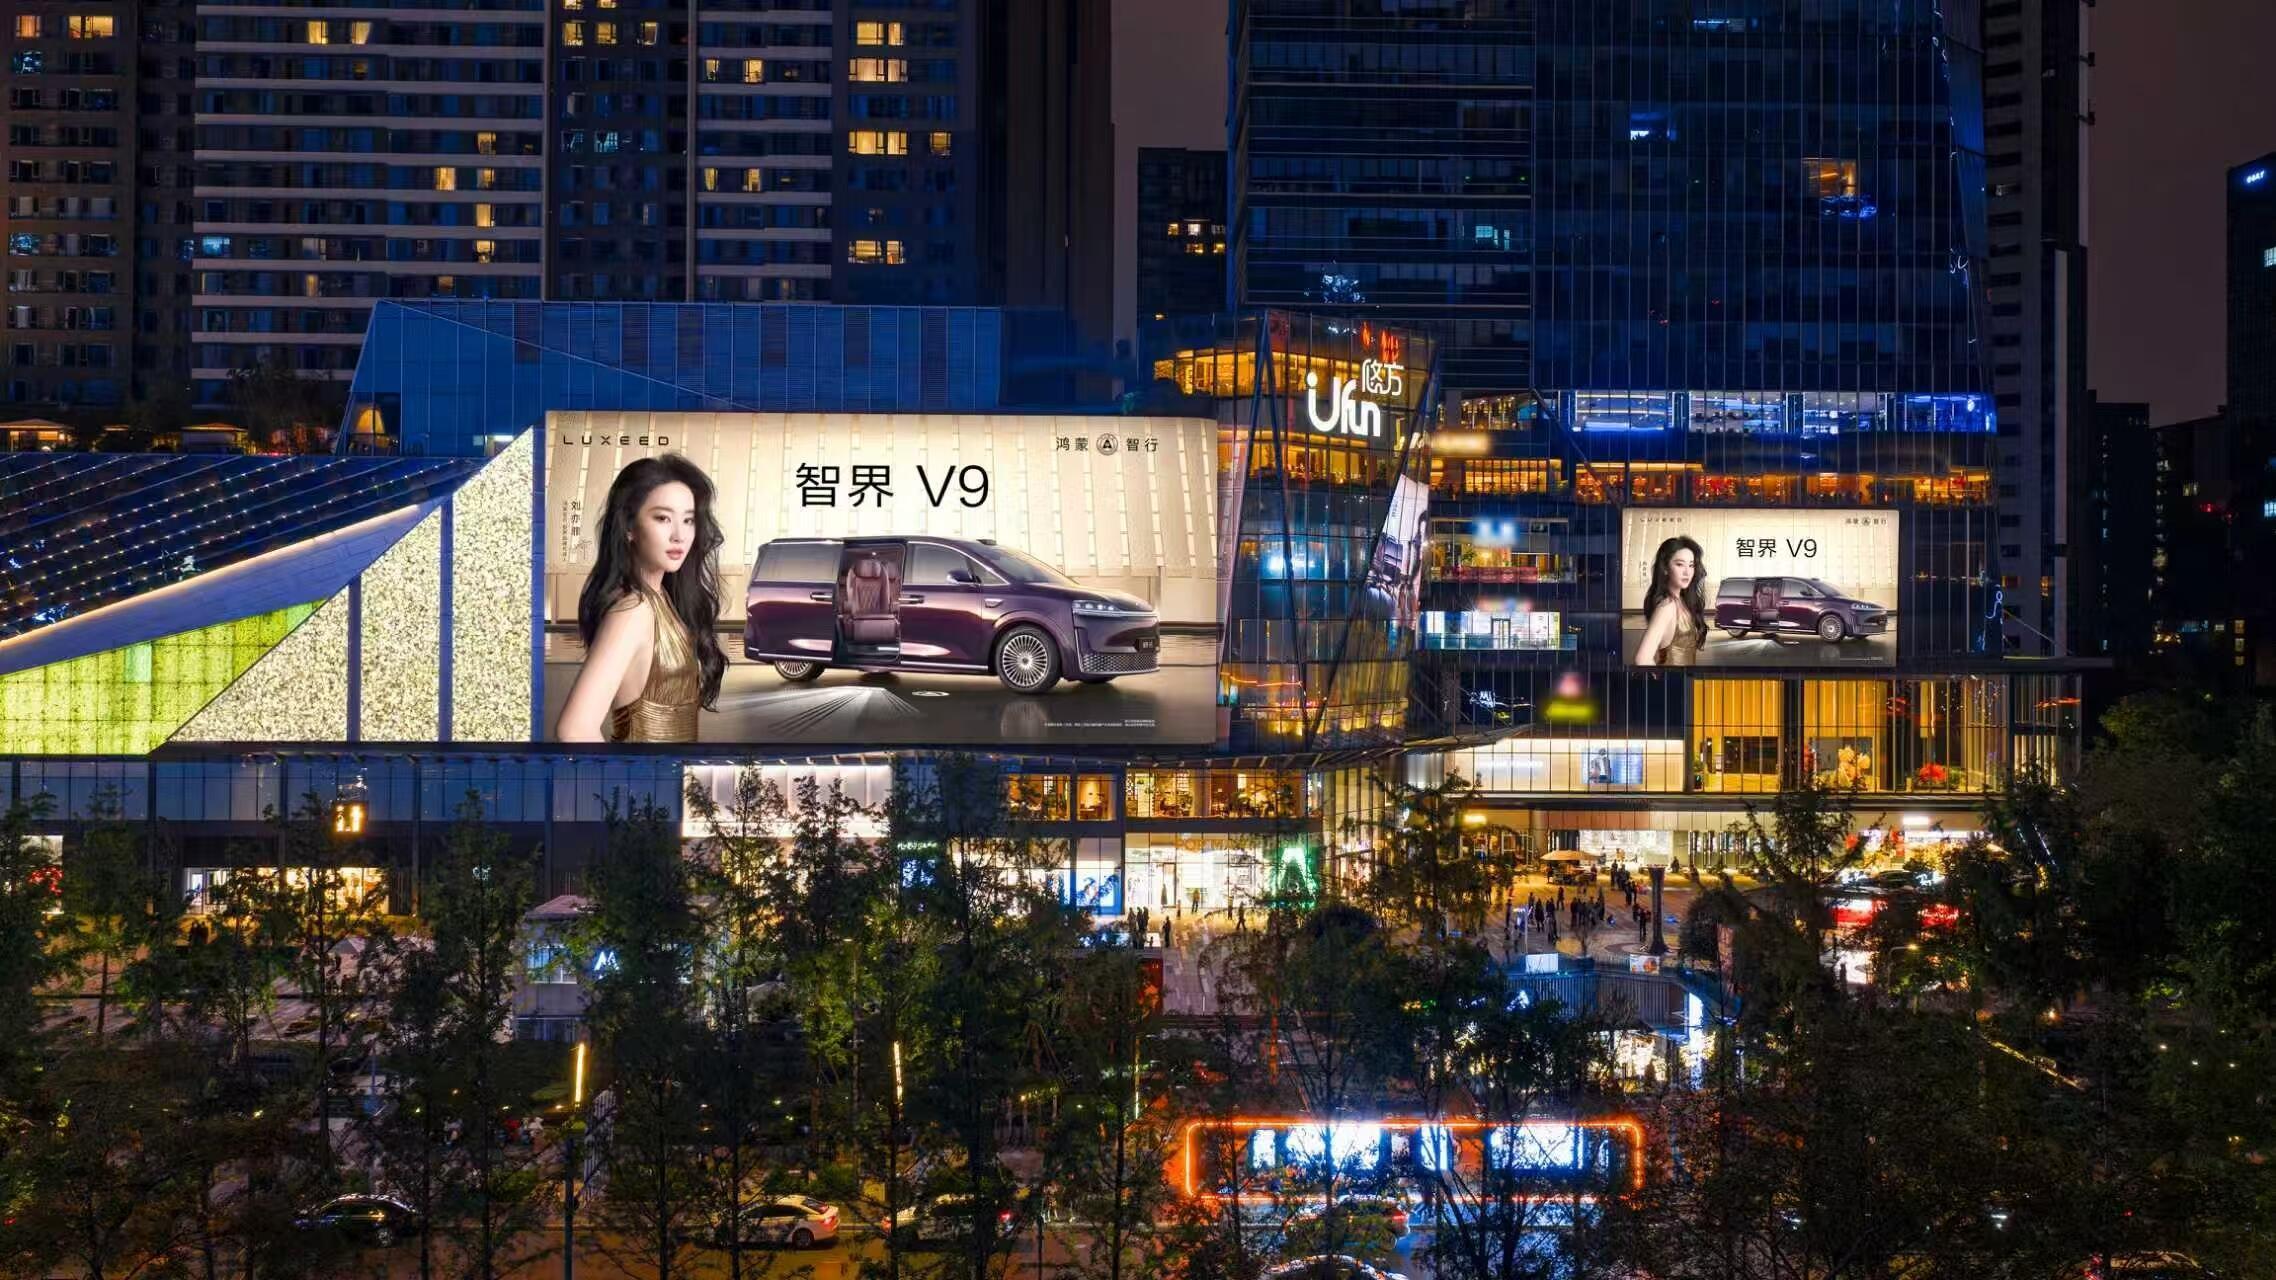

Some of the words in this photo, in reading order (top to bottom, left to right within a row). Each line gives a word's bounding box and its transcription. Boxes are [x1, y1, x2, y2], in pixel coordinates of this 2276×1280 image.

[562, 435, 669, 446] LUXEED
[1126, 437, 1159, 452] 智行
[796, 463, 894, 508] 智界
[916, 464, 989, 508] V9
[1736, 537, 1777, 558] 智界
[1786, 538, 1817, 558] V9
